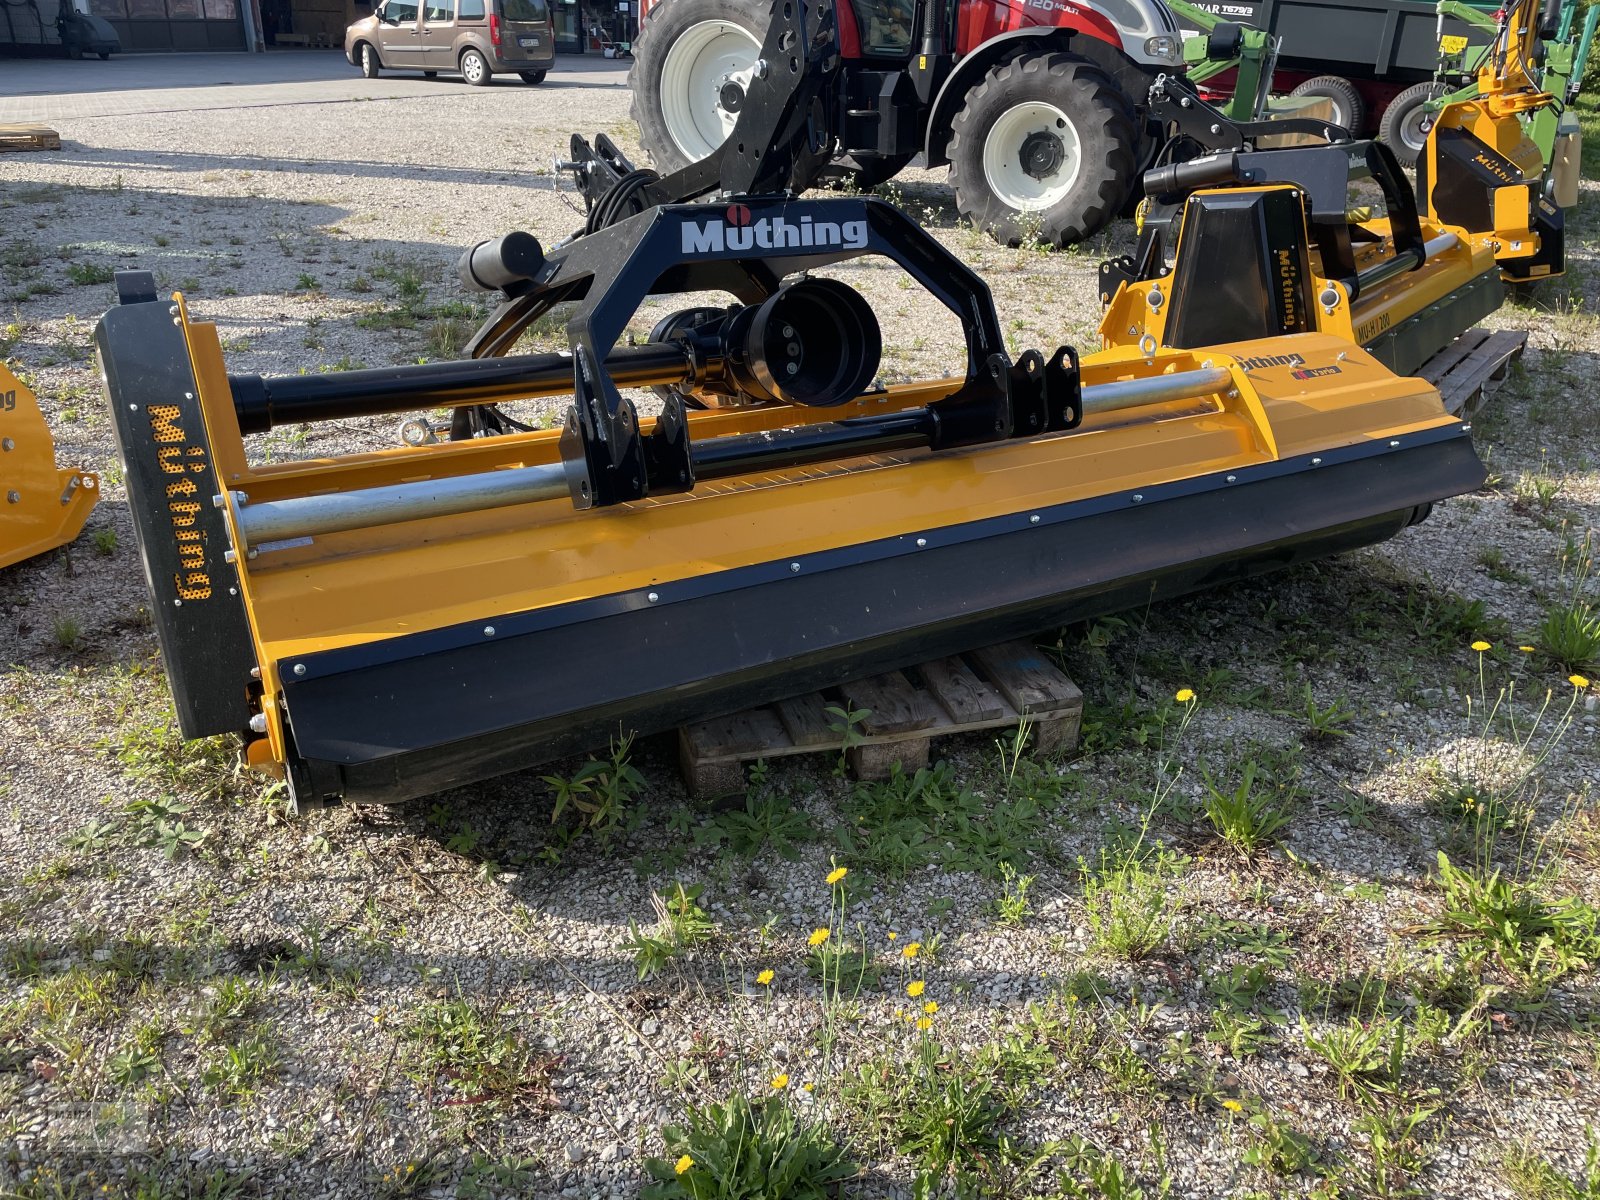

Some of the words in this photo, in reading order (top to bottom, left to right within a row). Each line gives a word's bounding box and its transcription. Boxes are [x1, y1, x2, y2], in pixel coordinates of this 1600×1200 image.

[1054, 2, 1079, 15] MULTI
[681, 204, 869, 254] Müthing
[1279, 249, 1296, 326] Müthing
[1379, 312, 1391, 331] 200
[1311, 365, 1336, 377] Vario
[147, 404, 213, 600] Müthing
